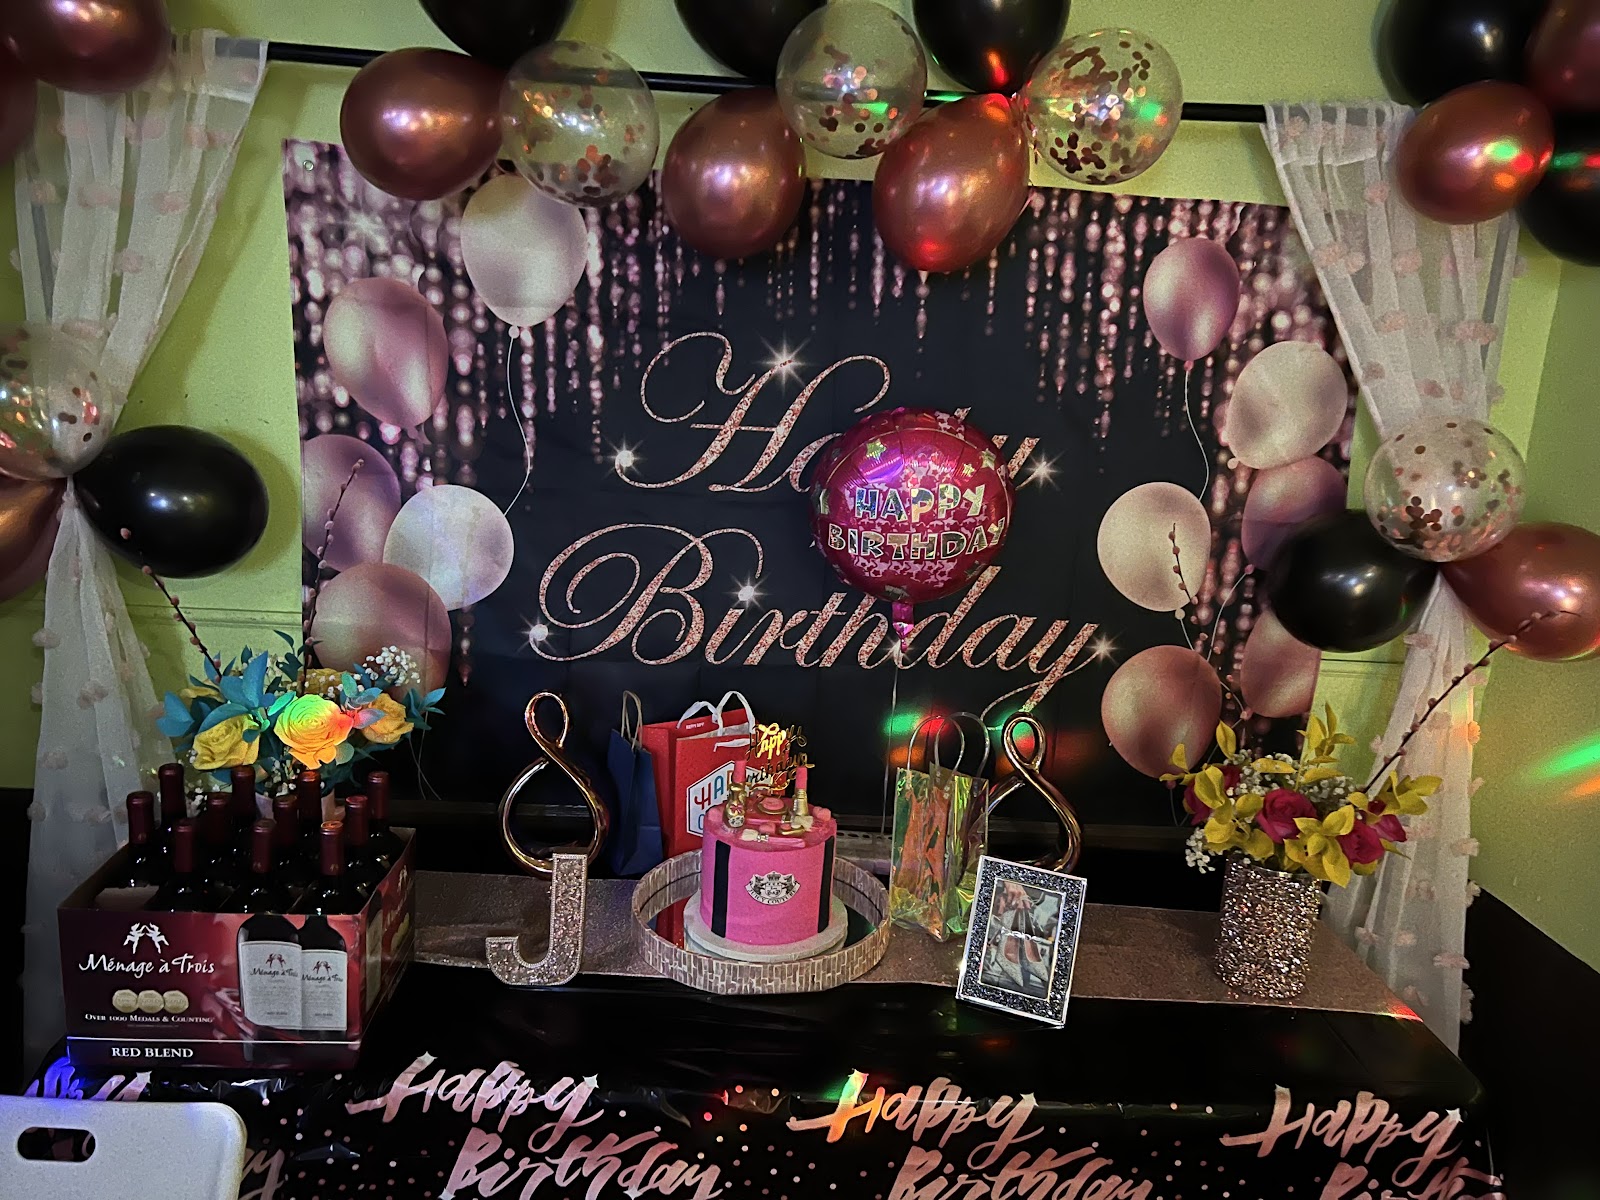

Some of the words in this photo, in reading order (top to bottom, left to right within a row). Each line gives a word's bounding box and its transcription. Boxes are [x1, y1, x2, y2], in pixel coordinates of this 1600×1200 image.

[855, 483, 986, 522] HAPPY
[828, 517, 1005, 559] BIRTHDAY
[529, 522, 1101, 730] Birthday
[78, 953, 154, 978] Ménage
[158, 959, 170, 974] à
[172, 953, 215, 974] Trois
[162, 1014, 169, 1022] &
[111, 1047, 141, 1057] RED
[145, 1047, 193, 1058] BLEND
[345, 1050, 604, 1152] Happy
[787, 1068, 1045, 1169] Happy
[1219, 1083, 1463, 1187] Happy
